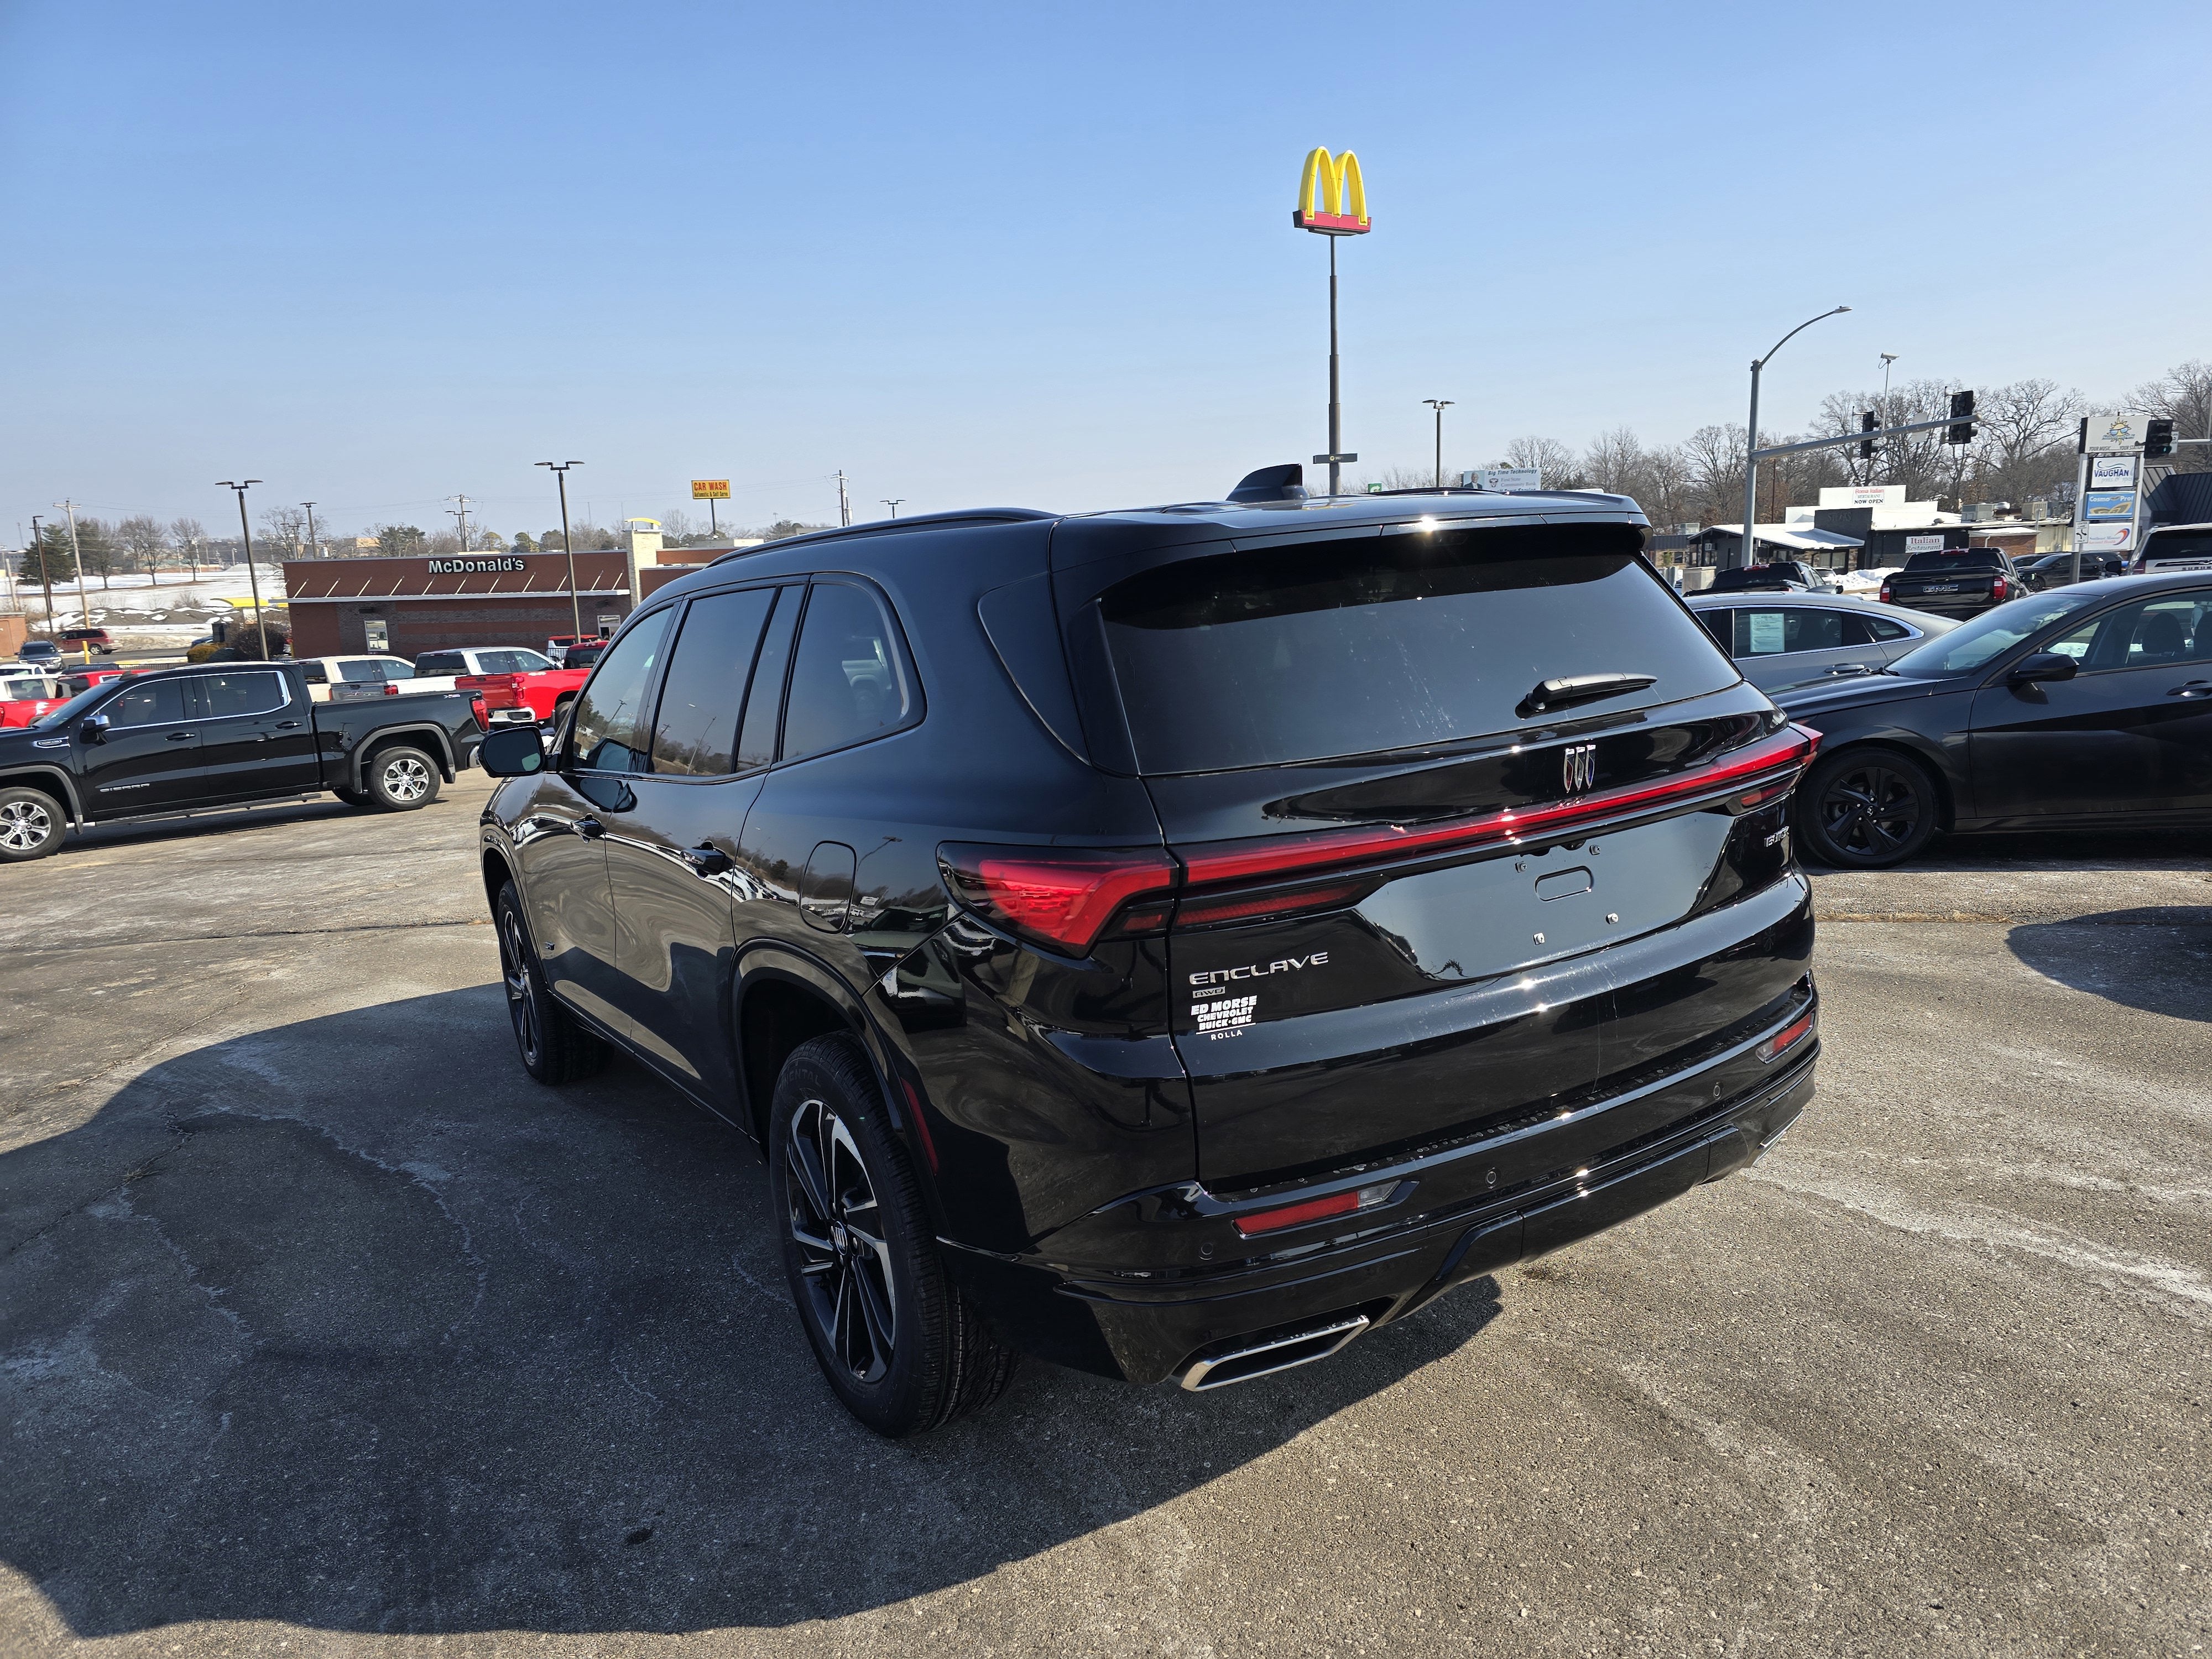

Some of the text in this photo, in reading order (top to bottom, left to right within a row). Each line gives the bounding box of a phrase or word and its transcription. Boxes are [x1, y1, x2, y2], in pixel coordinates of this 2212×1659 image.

[429, 558, 524, 573] McDonald's
[1923, 584, 1959, 593] GMC
[1189, 952, 1329, 985] ENCLAVE
[1194, 988, 1224, 997] AWD
[1191, 995, 1257, 1016] ED MORSE
[1197, 1006, 1254, 1022] CHEVROLET
[1211, 1030, 1243, 1041] ROLLA
